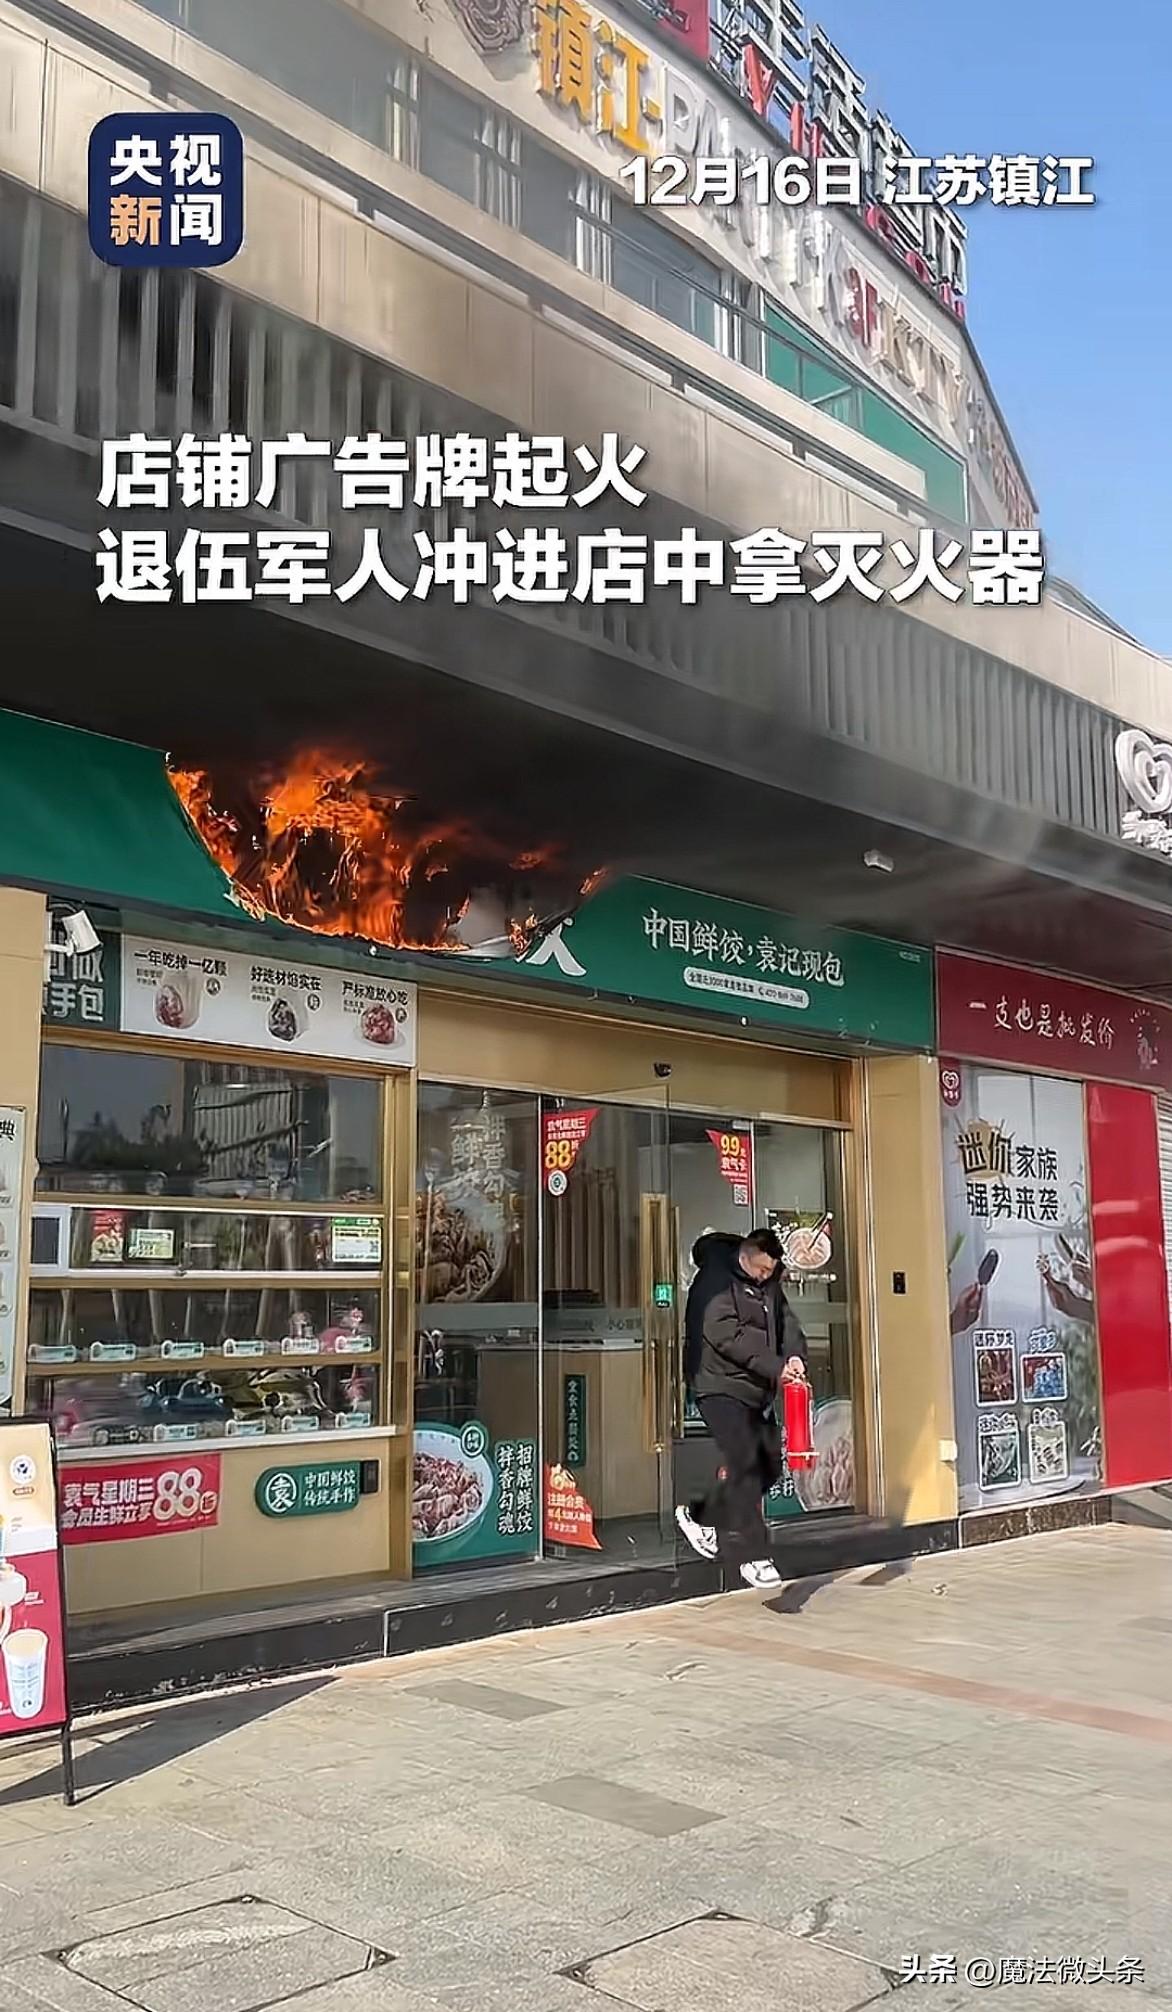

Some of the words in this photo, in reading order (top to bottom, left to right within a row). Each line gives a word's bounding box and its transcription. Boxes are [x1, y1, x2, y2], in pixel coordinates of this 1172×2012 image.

[969, 995, 1115, 1050] 一支也是批发价
[545, 1140, 572, 1169] 88
[957, 1131, 1058, 1181] 迷你家族
[966, 1182, 1059, 1221] 强势来袭
[153, 1467, 203, 1521] 88
[304, 1469, 356, 1489] 中国鲜饺
